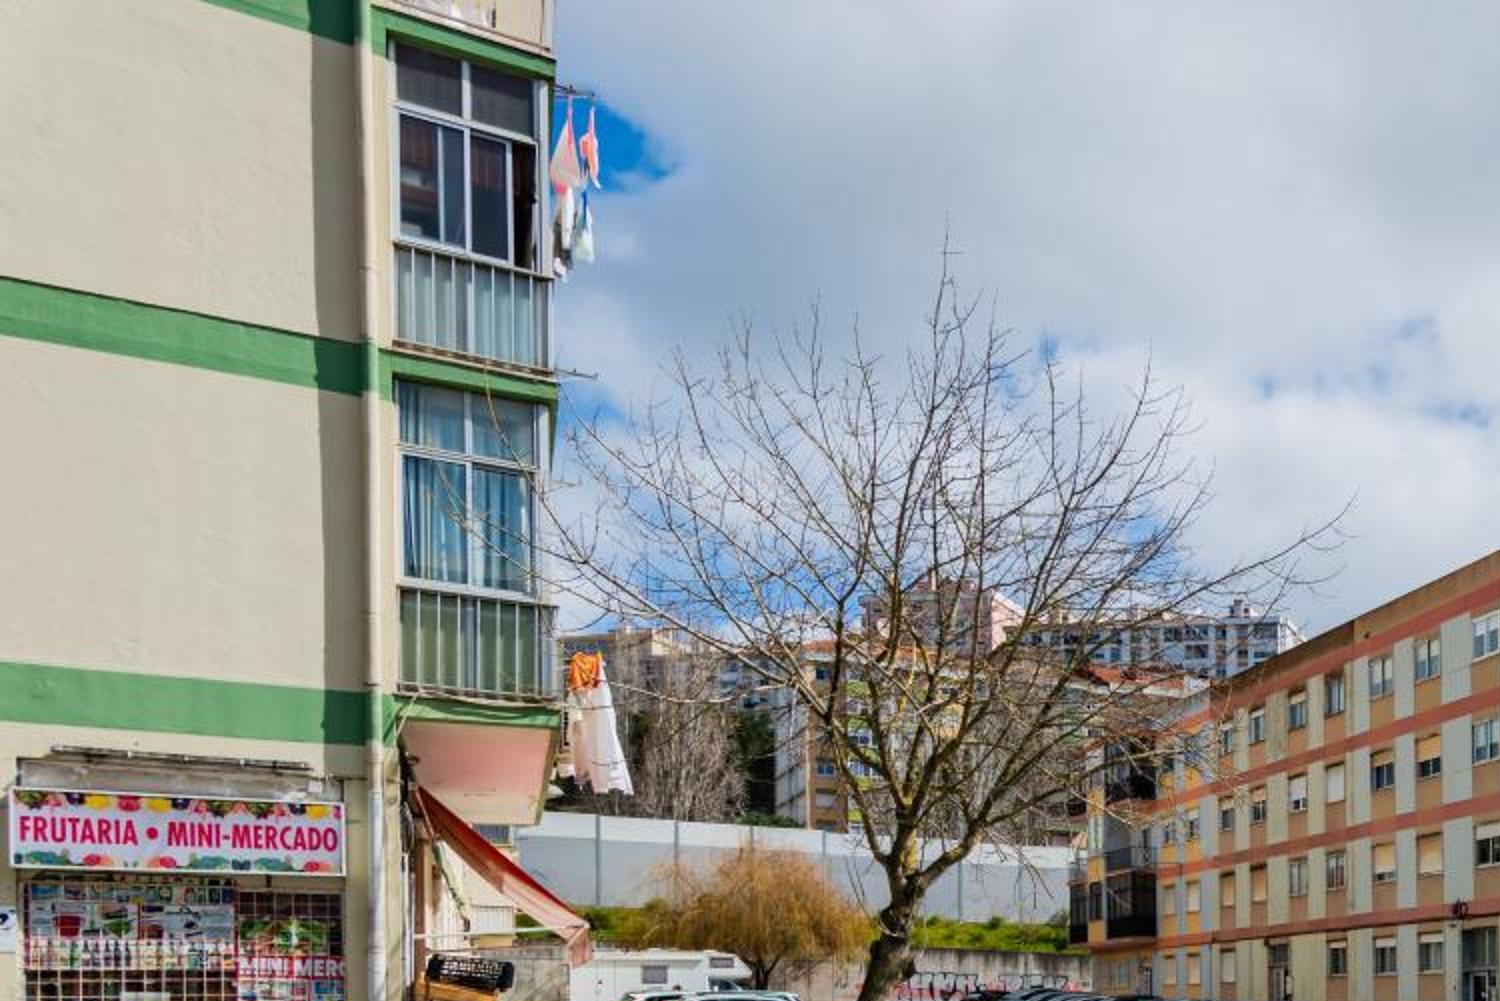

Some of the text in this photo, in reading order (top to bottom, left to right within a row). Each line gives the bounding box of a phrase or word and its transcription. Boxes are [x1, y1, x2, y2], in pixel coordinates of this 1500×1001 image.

[19, 815, 338, 852] FRUTARIA MINI-MERCADO
[240, 957, 288, 976] MINI
